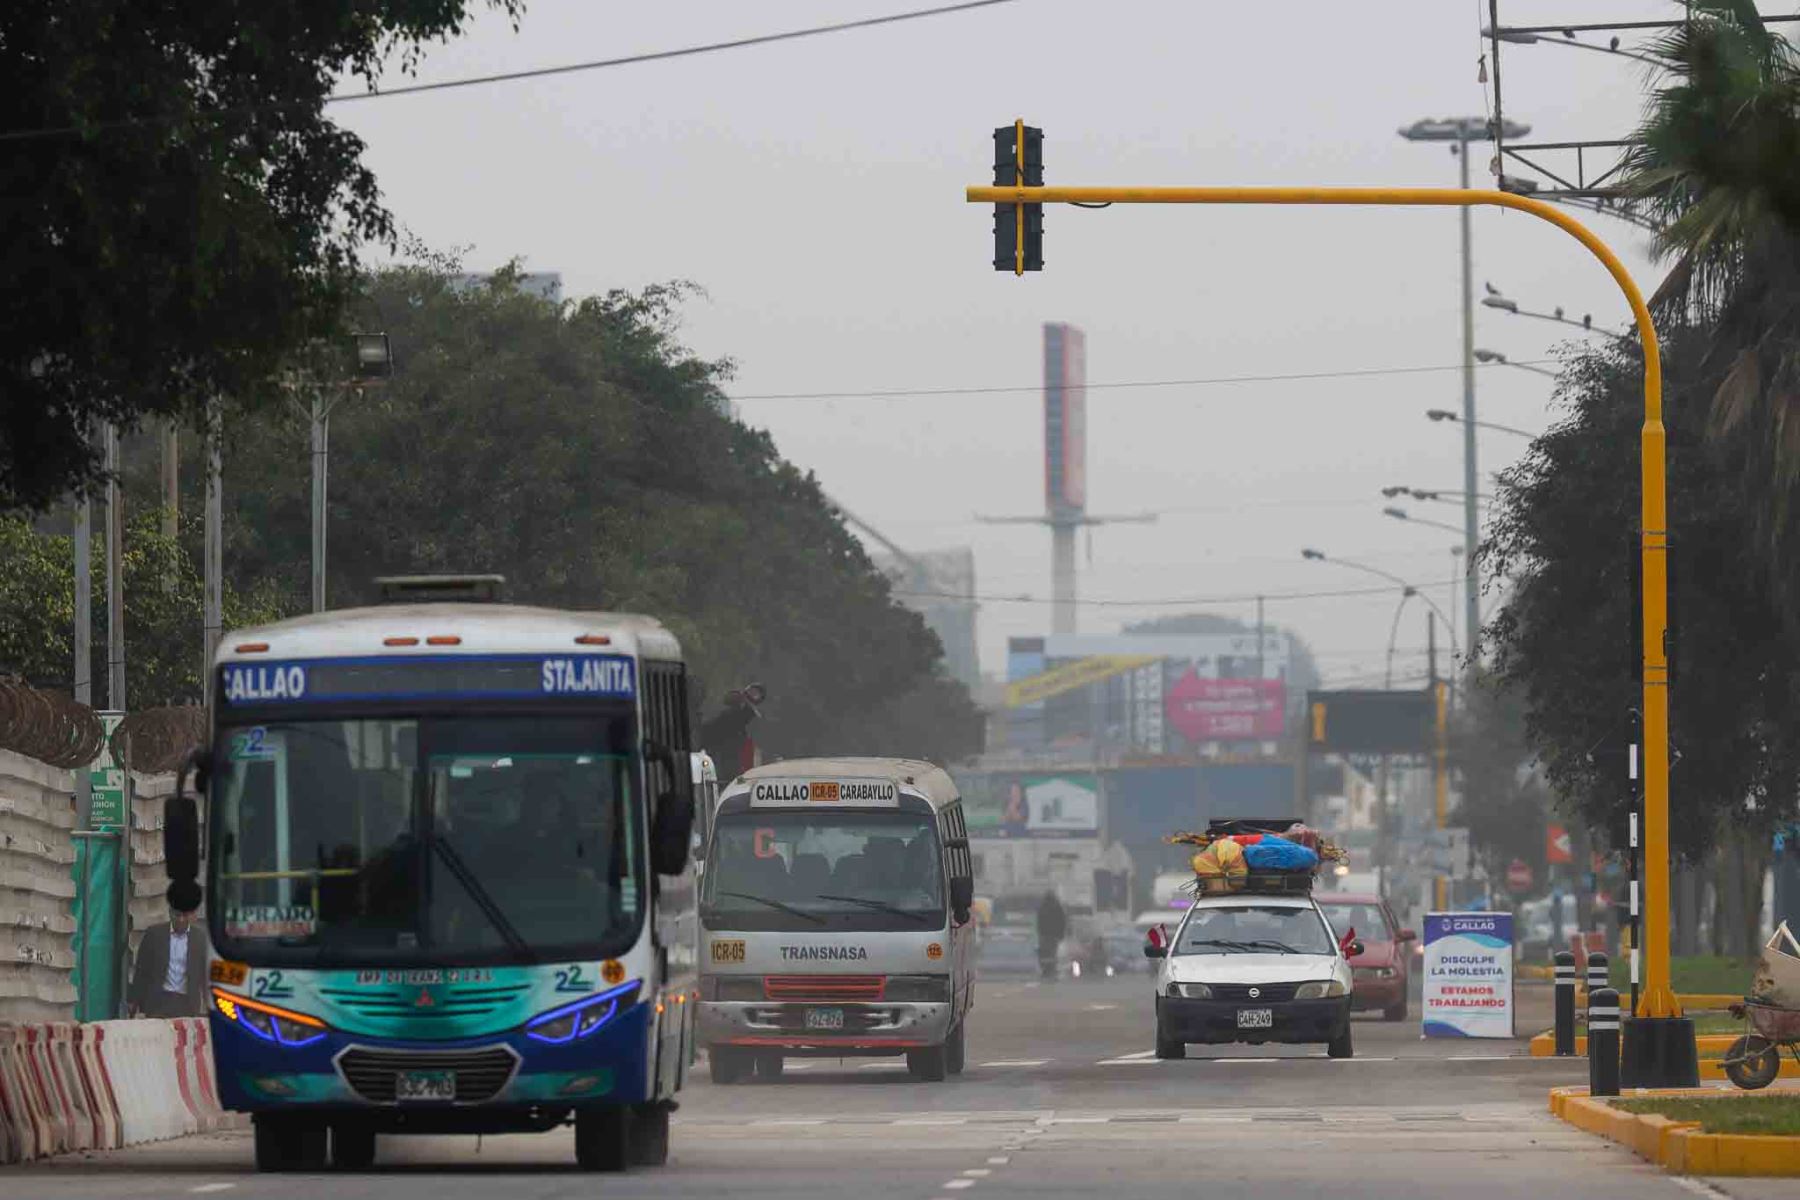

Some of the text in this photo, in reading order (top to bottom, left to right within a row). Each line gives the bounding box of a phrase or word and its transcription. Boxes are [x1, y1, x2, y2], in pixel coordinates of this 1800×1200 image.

[543, 659, 633, 692] STA.ANITA
[756, 785, 893, 800] CALLAO ICR-05 CARABAYLLO
[754, 828, 776, 858] C
[1453, 922, 1496, 930] CALLAO
[711, 944, 745, 960] ICR-05
[780, 946, 867, 960] TRANSNASA
[1441, 956, 1495, 964] DISCULPE
[555, 964, 593, 991] 22
[1431, 967, 1504, 976] LA MOLESTIA
[256, 969, 294, 997] 22
[1441, 986, 1494, 995] ESTAMOS
[1428, 999, 1505, 1008] TRABAJANDO
